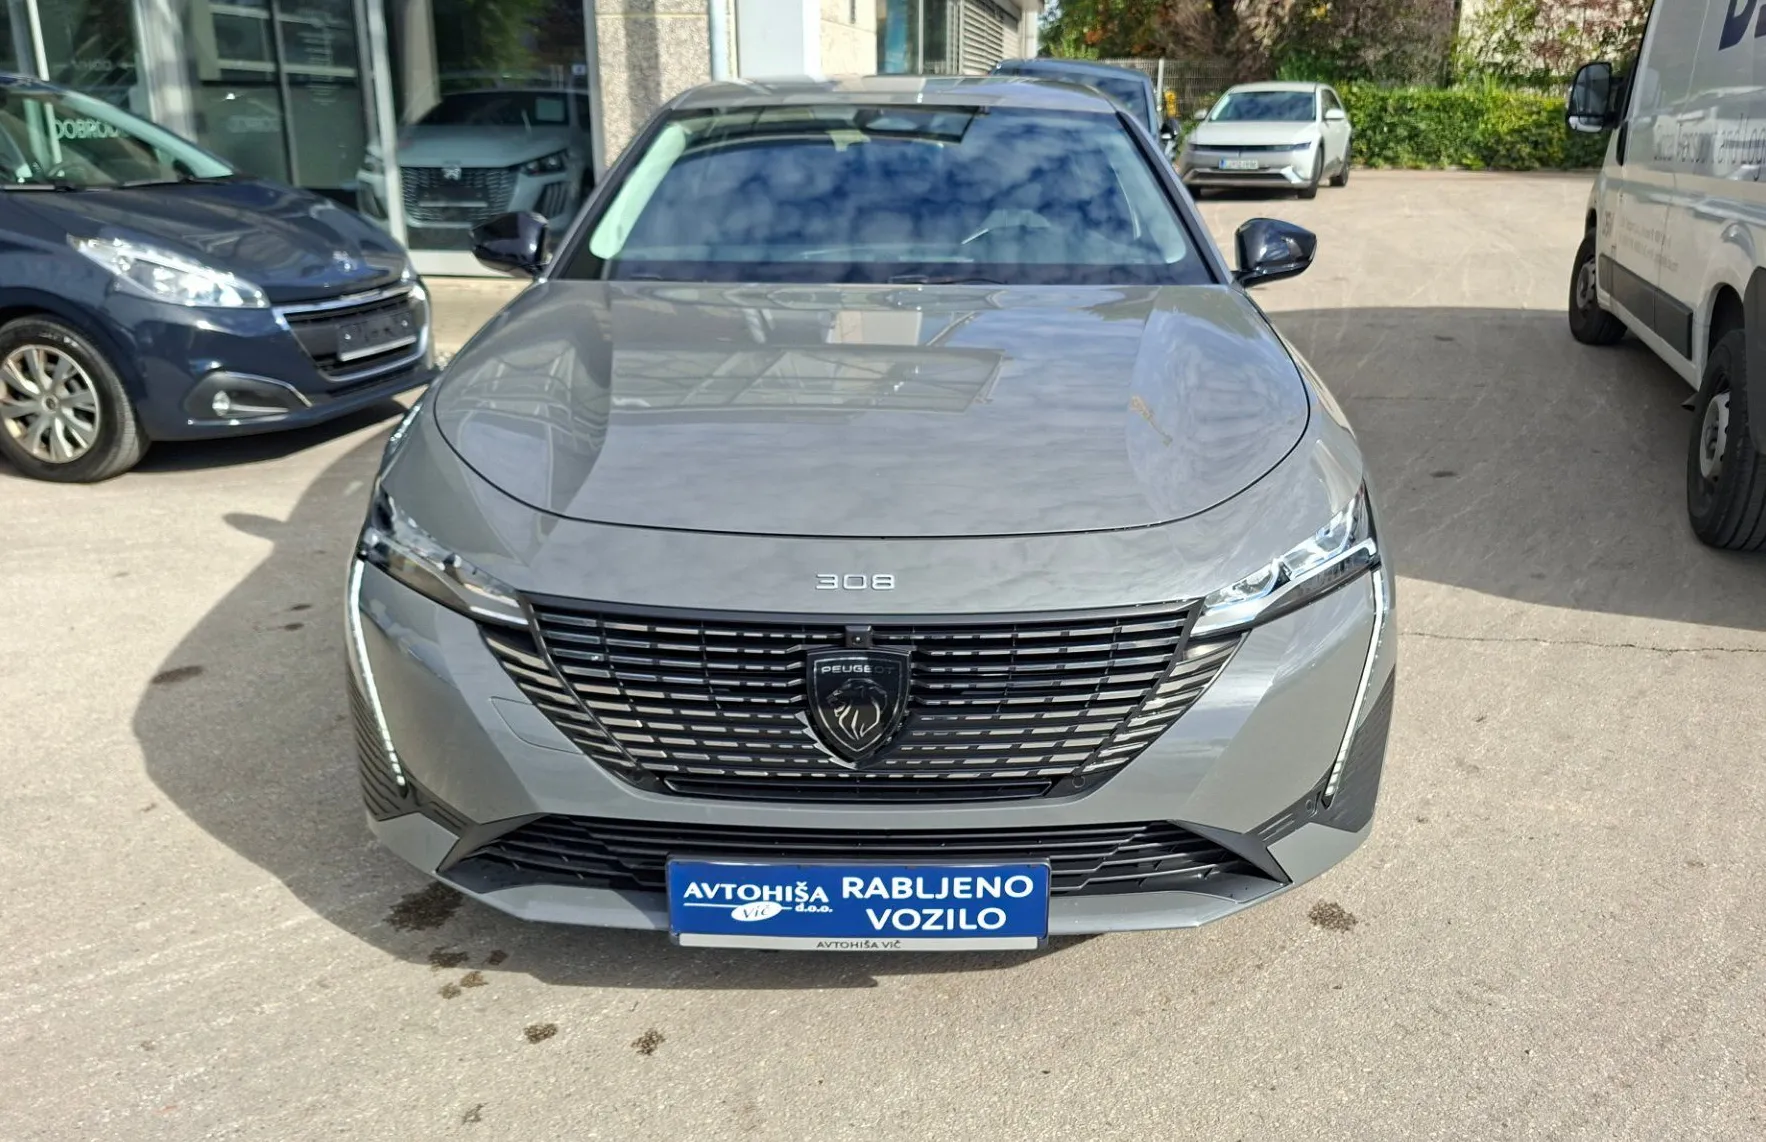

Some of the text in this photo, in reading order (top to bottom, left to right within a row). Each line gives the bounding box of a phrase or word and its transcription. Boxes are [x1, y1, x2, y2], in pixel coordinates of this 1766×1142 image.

[816, 573, 895, 590] 308
[821, 664, 895, 674] PEUGEOT
[683, 881, 829, 903] AVTOHIŠA
[842, 875, 1034, 899] RABLJENO
[795, 903, 833, 913] d.o.o.
[866, 907, 1007, 931] VOZILO
[817, 939, 879, 949] AVTOHIŠA
